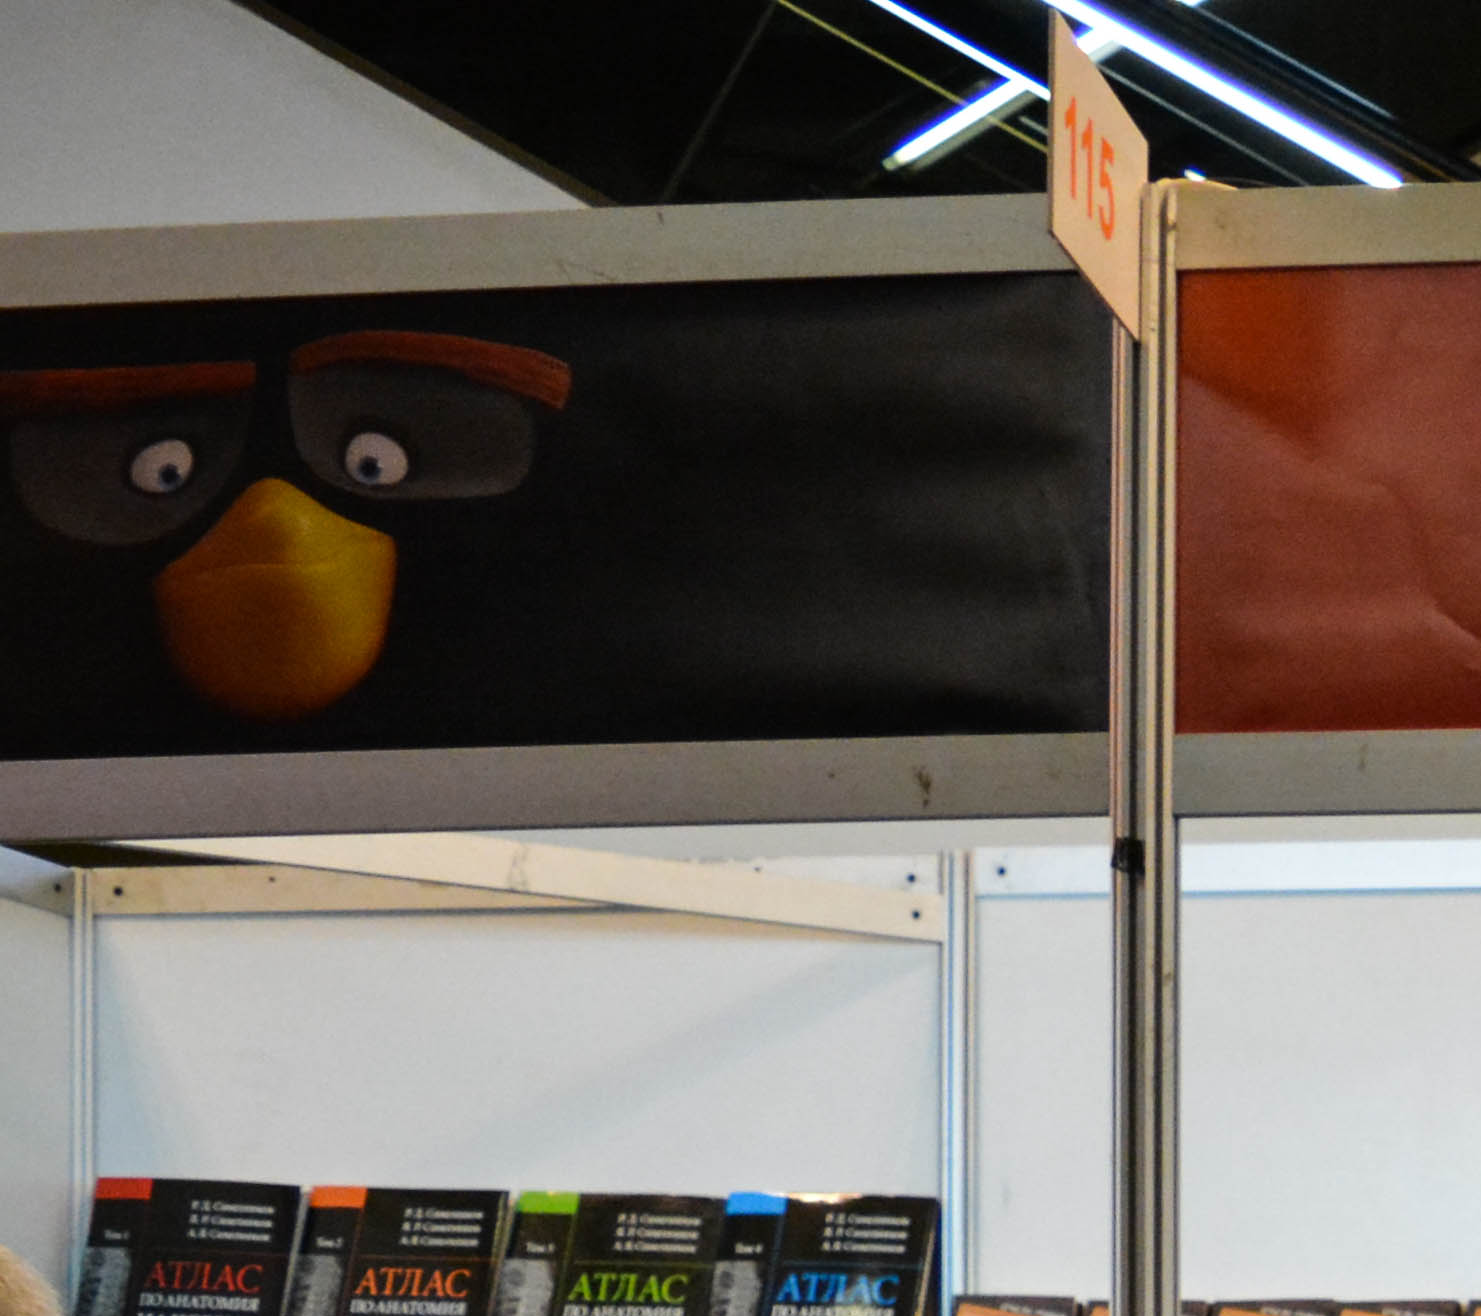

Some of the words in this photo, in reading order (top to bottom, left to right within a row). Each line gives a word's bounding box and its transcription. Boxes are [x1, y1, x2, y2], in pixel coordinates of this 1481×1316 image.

[1065, 96, 1115, 241] 115
[145, 1261, 263, 1293] АТЛАС
[355, 1268, 472, 1298] АТЛАС
[568, 1273, 689, 1304] АТЛАС
[777, 1273, 900, 1305] АТЛАС
